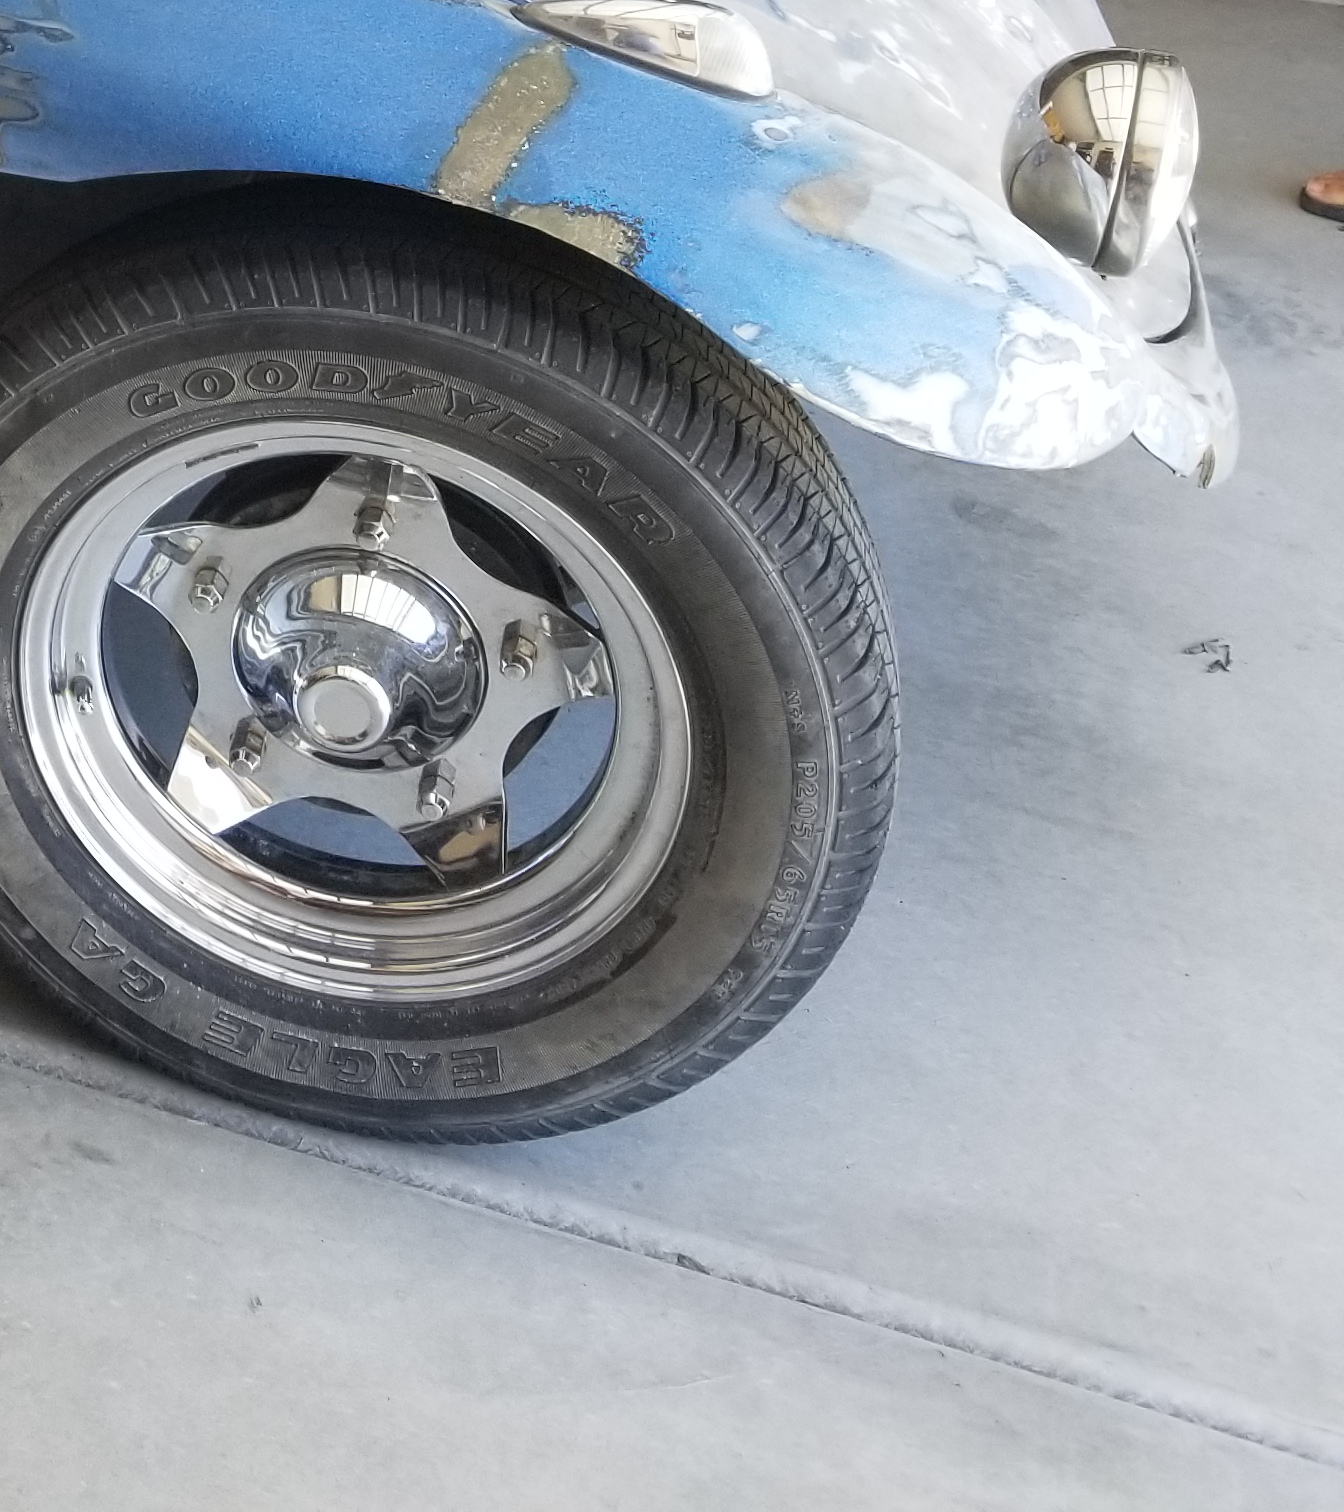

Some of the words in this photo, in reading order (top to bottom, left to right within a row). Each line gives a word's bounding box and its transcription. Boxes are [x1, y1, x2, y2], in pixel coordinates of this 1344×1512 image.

[128, 357, 676, 547] GOODYEAR
[70, 918, 168, 1003] GA
[202, 1007, 504, 1088] EAGLE
